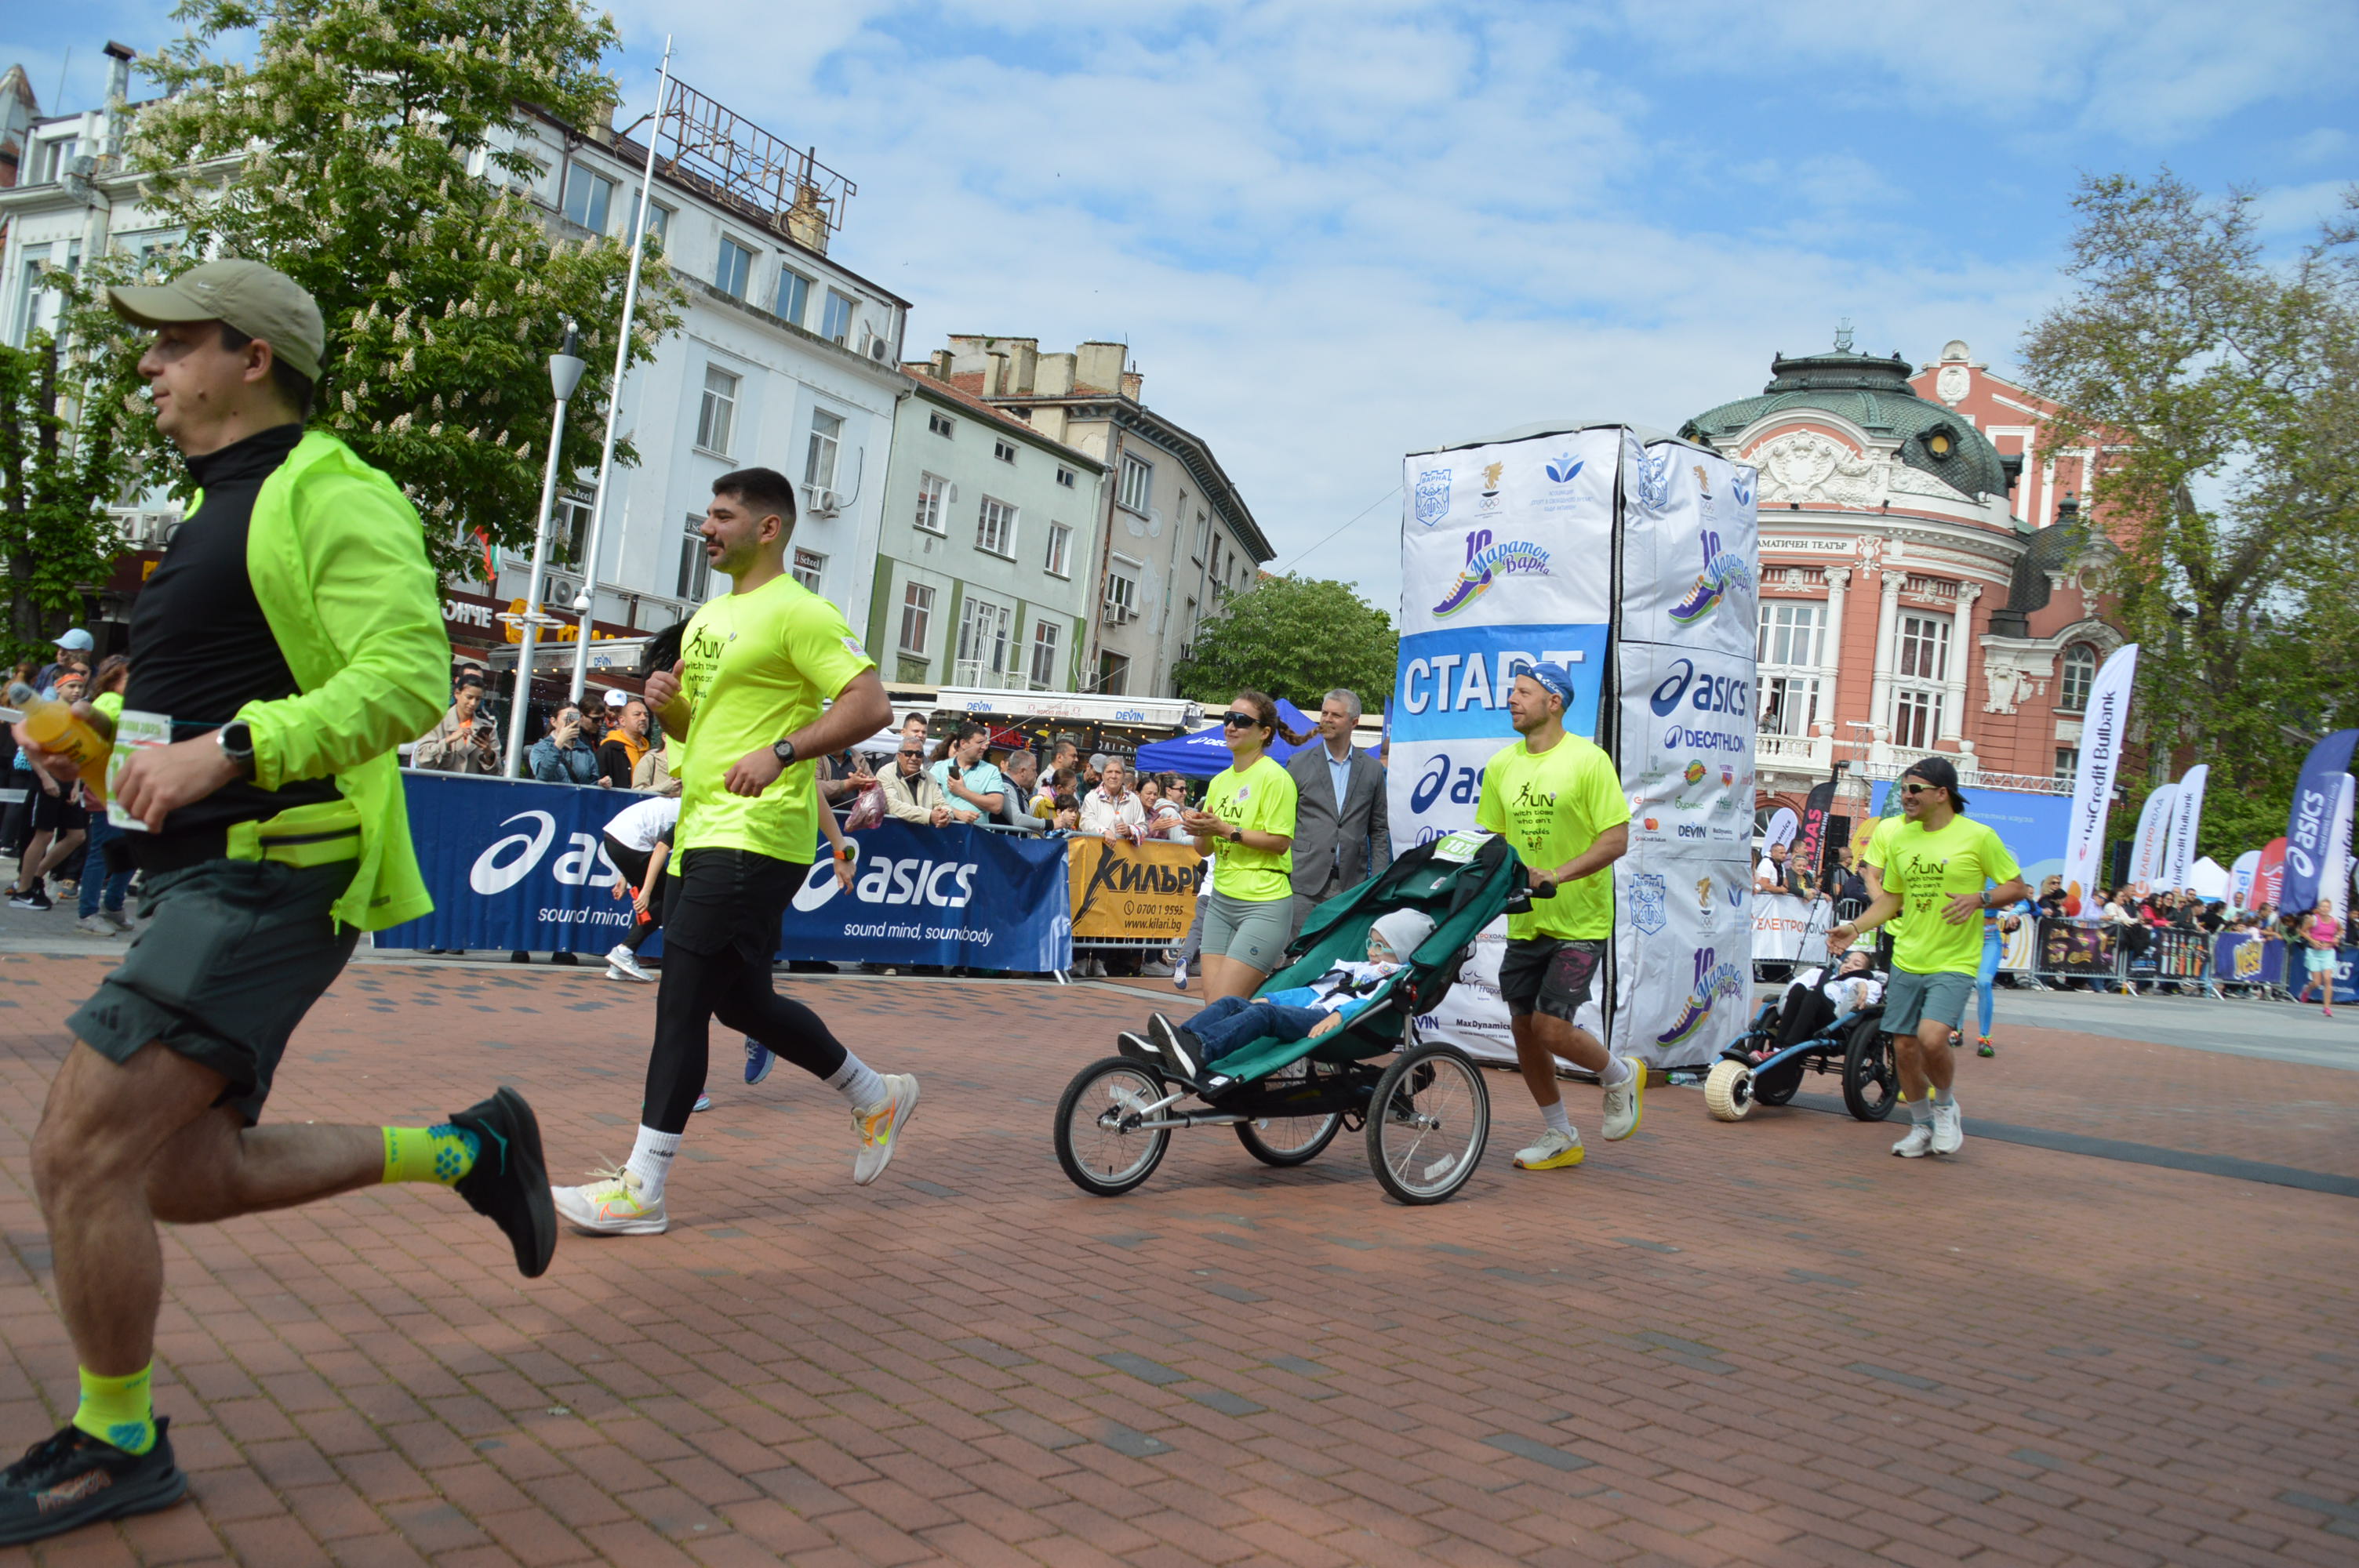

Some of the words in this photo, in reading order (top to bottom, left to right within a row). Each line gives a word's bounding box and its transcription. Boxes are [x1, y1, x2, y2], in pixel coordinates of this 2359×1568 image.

[1466, 528, 1492, 568] 10
[1700, 529, 1721, 572] 10
[1757, 539, 1808, 549] АМАТИЧЕН
[1812, 541, 1848, 550] ТЕАТЪР
[1470, 540, 1550, 578] Маратон
[1502, 553, 1550, 576] Варна
[442, 599, 493, 628] ОНЧЕ
[594, 655, 612, 666] DEVIN
[966, 701, 992, 712] DEVIN
[1692, 673, 1749, 717] asics
[1115, 710, 1144, 721] DEVIN
[2093, 691, 2116, 760] Bulbank
[1685, 729, 1746, 753] DECATHLON
[2083, 764, 2108, 841] UniCredit
[2178, 793, 2194, 835] Bulbank
[2294, 789, 2325, 849] asics
[1678, 825, 1707, 838] DEVIN
[2139, 797, 2165, 877] ЕЛЕКТРОХОЛД
[2172, 838, 2186, 886] UniCredit
[856, 855, 979, 908] asics
[538, 906, 590, 924] sound
[591, 908, 634, 929] mind,
[1136, 905, 1156, 915] 0700
[1158, 906, 1162, 914] 1
[1165, 905, 1183, 916] 9595
[843, 921, 887, 937] sound
[888, 922, 921, 941] mind,
[1124, 918, 1182, 932] www.kilari.bg
[1694, 947, 1714, 992] 10
[1479, 985, 1501, 996] Frapor
[1416, 1015, 1439, 1030] VIN
[1456, 1018, 1511, 1030] MaxDynamics
